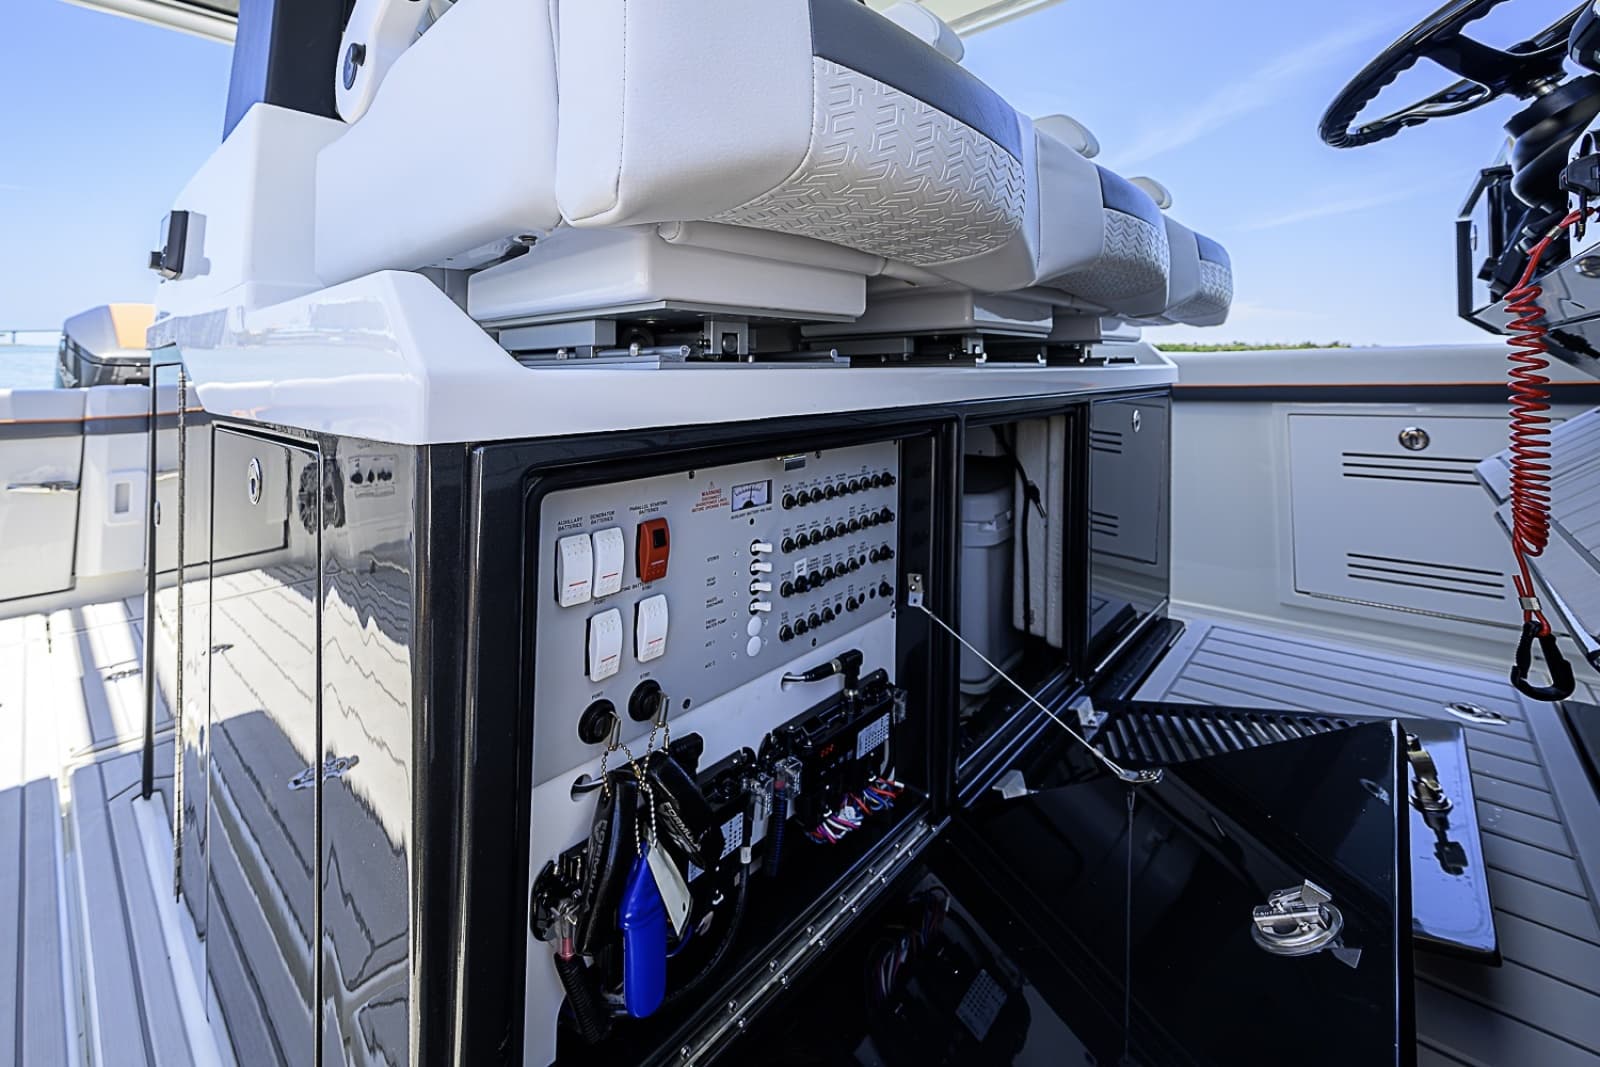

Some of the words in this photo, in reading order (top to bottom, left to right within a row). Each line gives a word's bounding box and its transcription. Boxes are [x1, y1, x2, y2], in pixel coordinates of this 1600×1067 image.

[590, 510, 615, 520] GENERATOR
[590, 516, 614, 525] BATTERIES
[557, 522, 582, 531] BATTERIES
